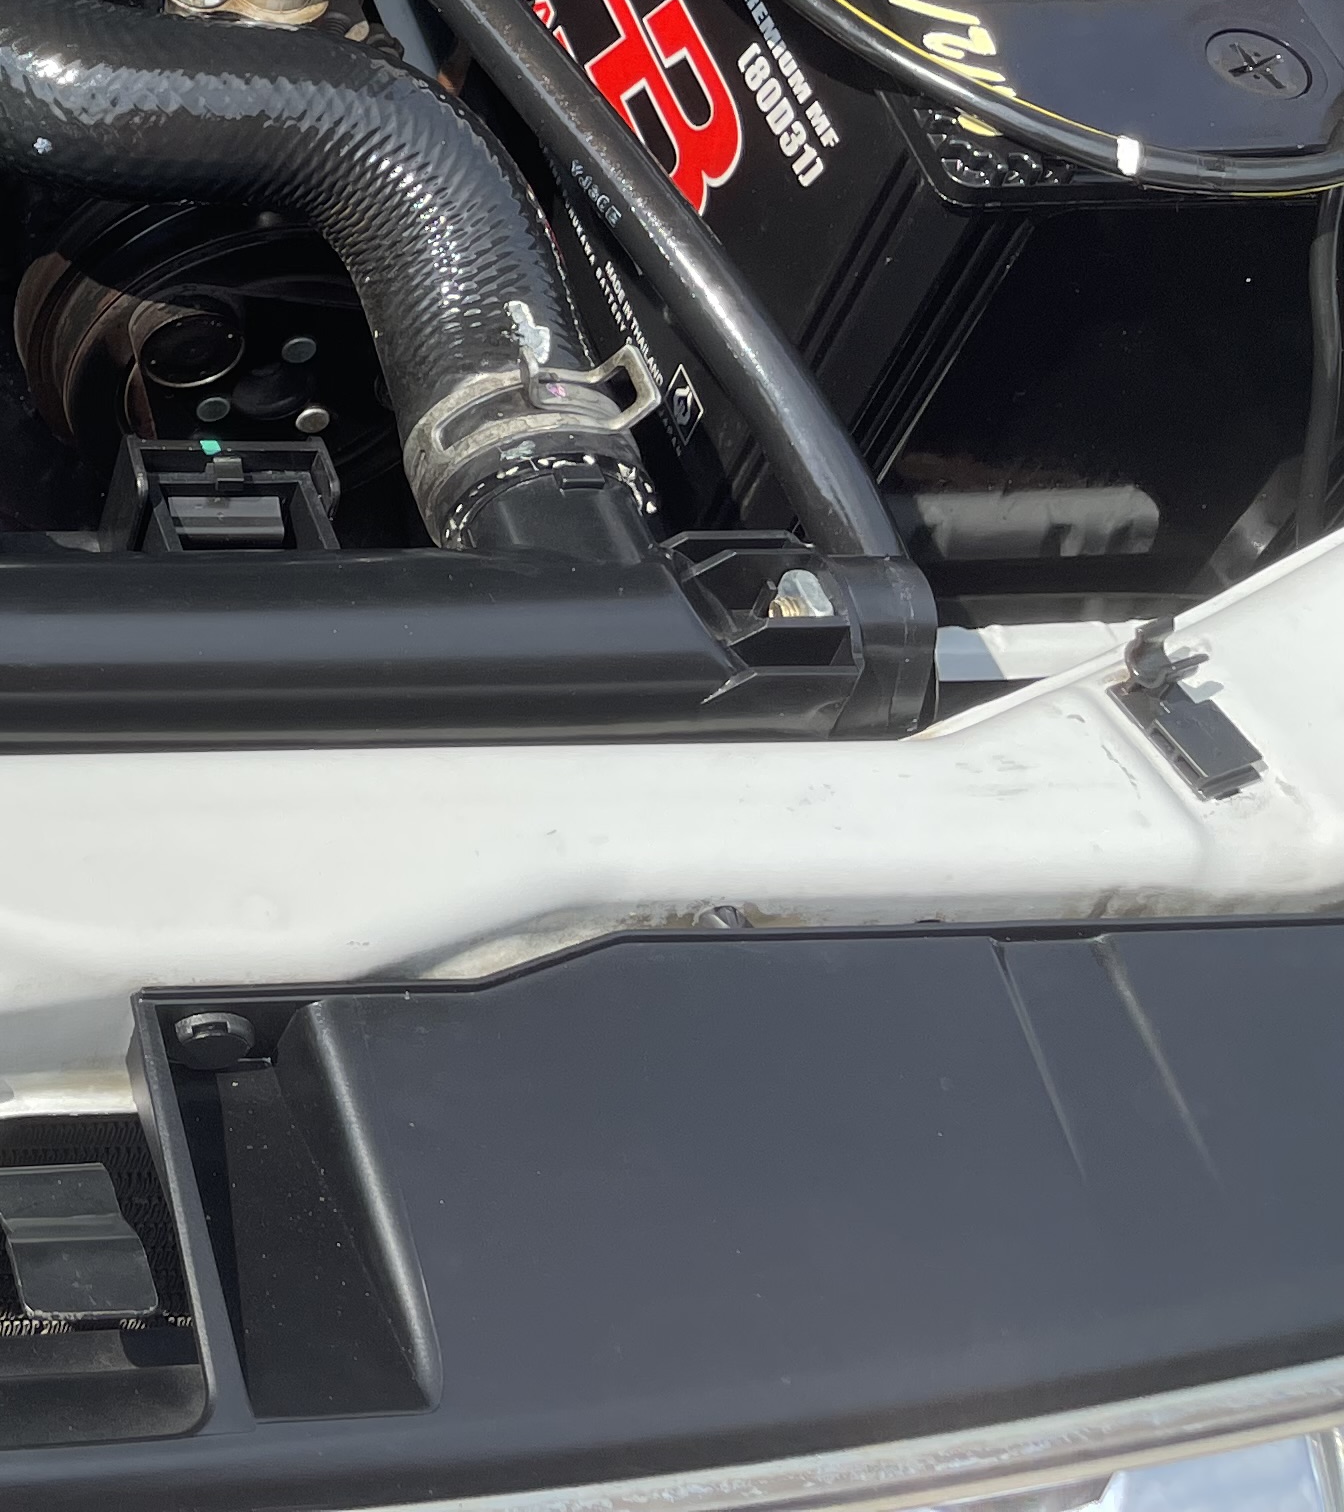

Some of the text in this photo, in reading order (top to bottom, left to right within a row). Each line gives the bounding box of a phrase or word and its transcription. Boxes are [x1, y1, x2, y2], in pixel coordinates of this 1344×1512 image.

[804, 99, 841, 149] MF
[594, 265, 628, 333] BATTERY
[604, 260, 627, 306] MADE
[629, 316, 665, 388] THAILAND
